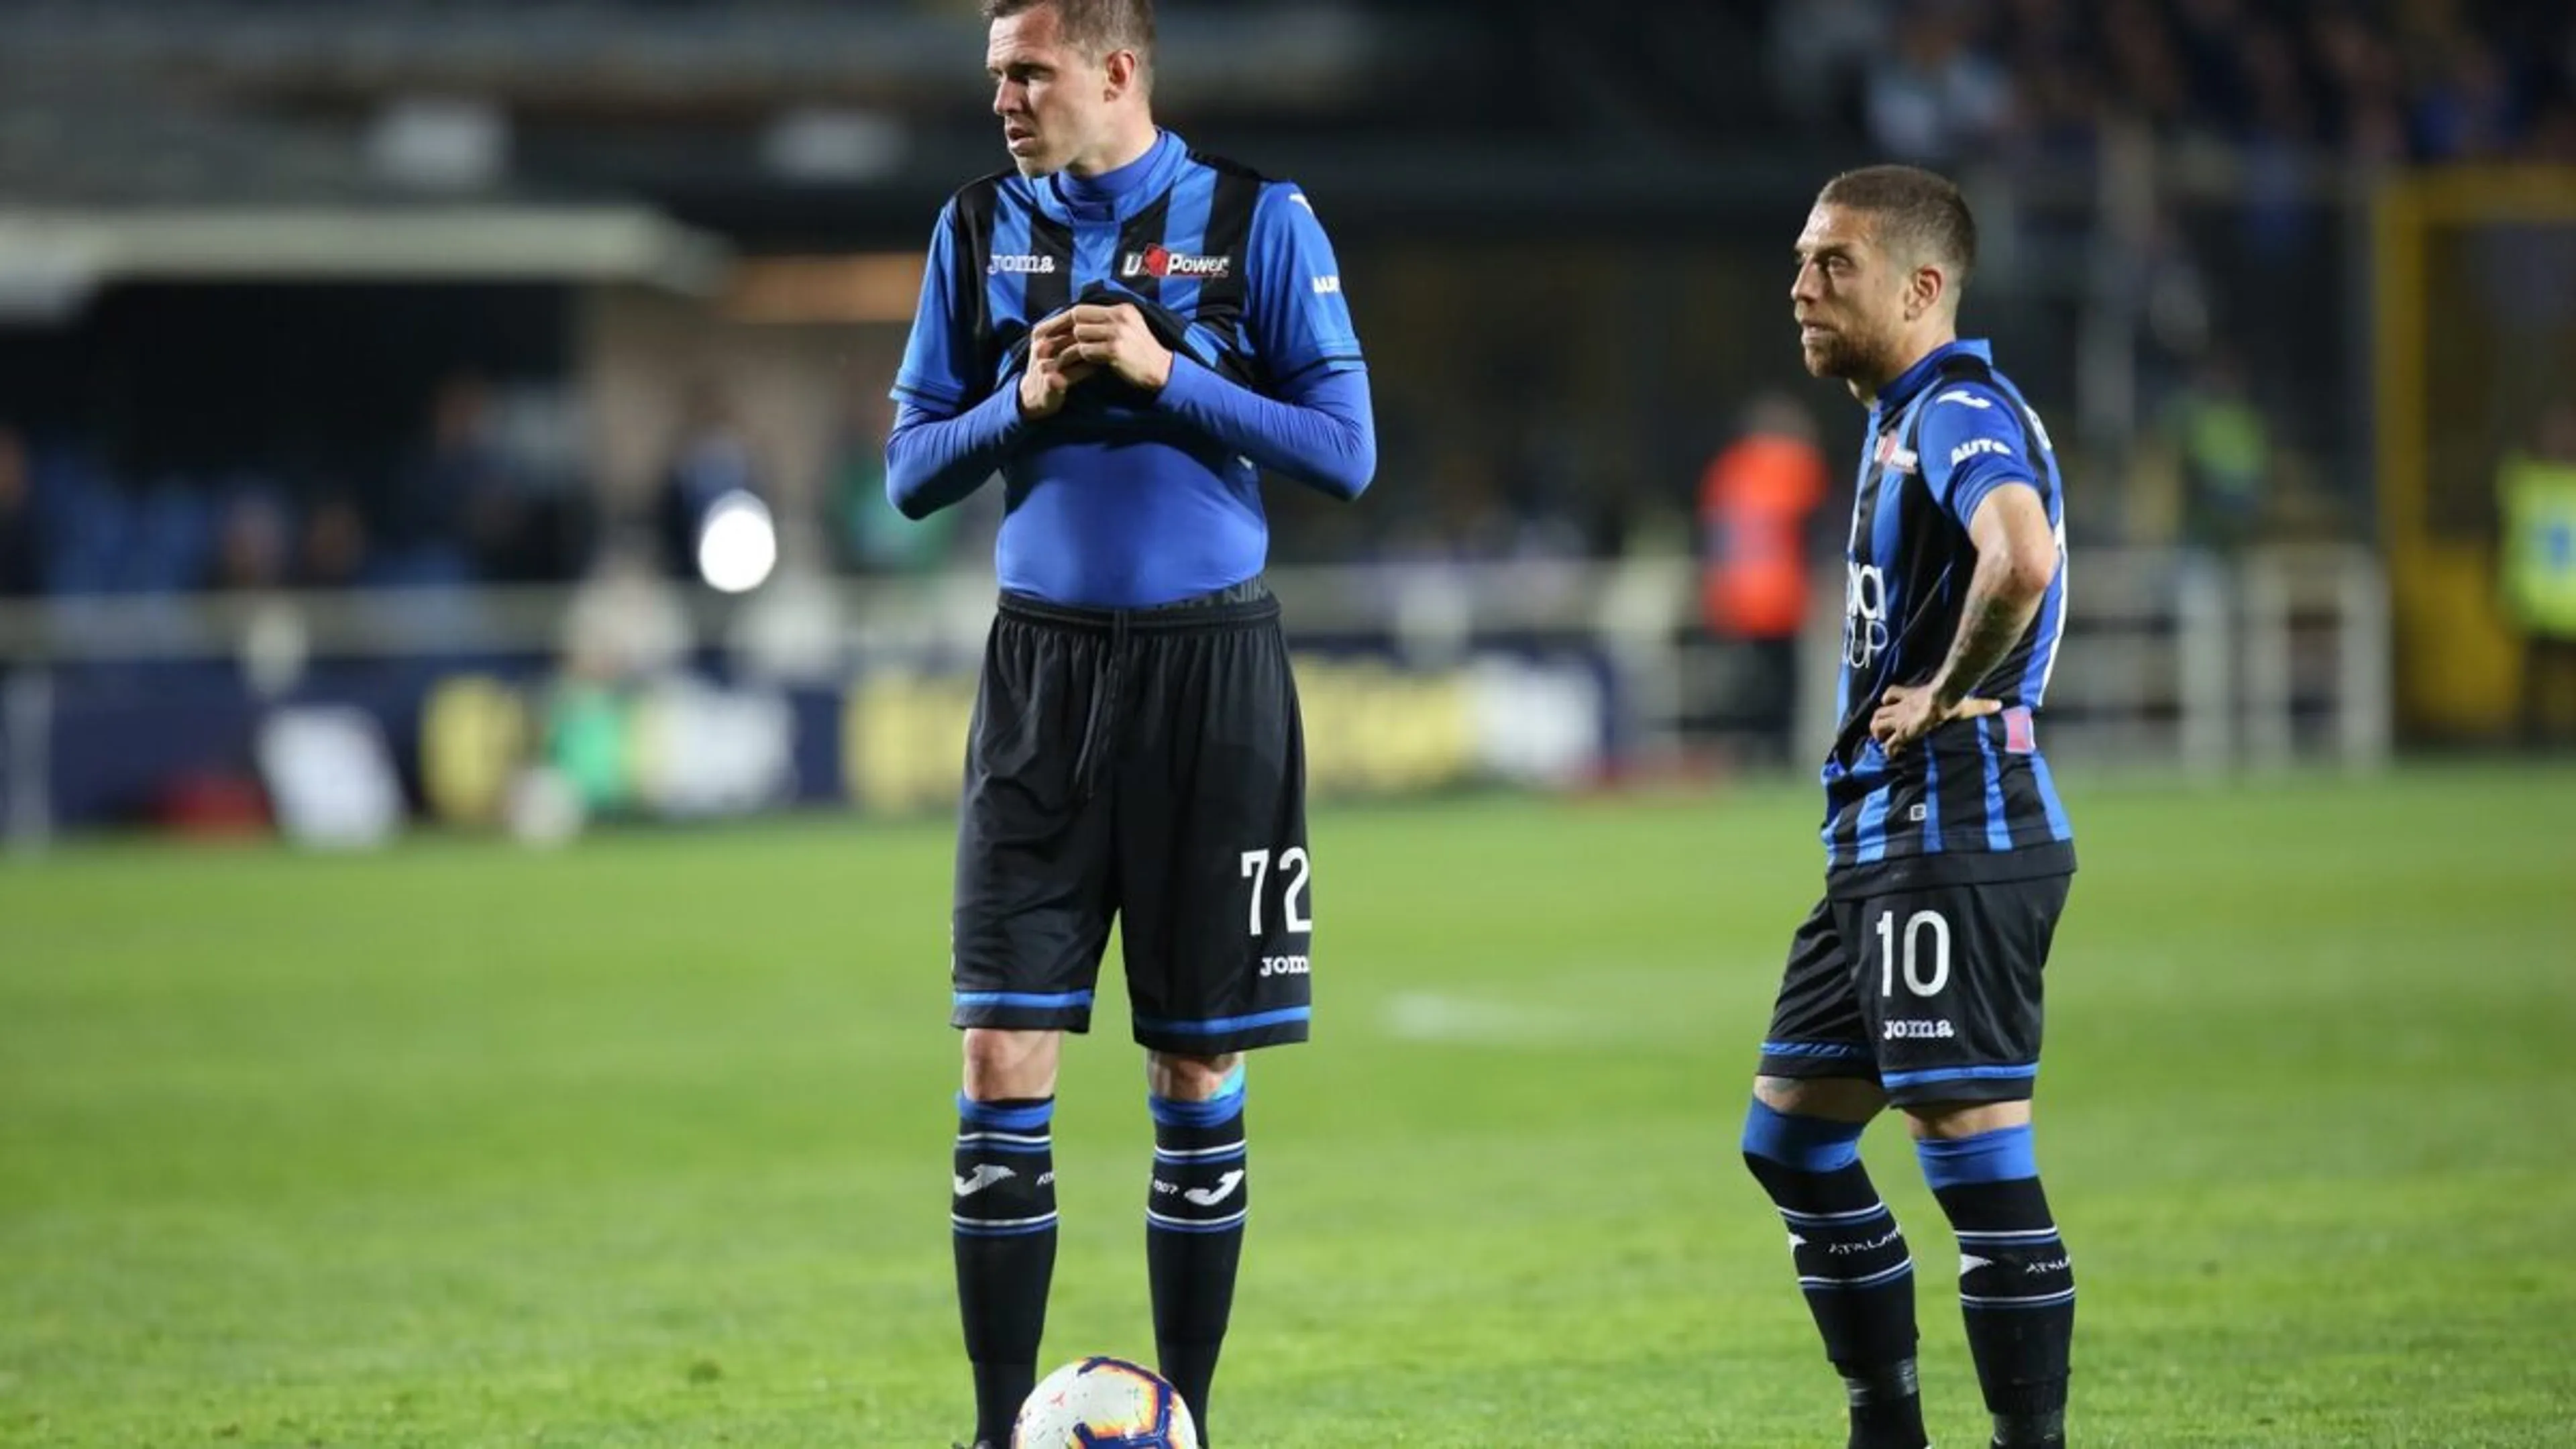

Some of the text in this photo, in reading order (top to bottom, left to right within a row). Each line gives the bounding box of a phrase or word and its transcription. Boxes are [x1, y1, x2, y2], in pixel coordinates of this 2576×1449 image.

[1121, 252, 1230, 277] U Power
[1950, 438, 2011, 467] AUTO
[1241, 846, 1313, 936] 72
[1876, 909, 1951, 998] 10
